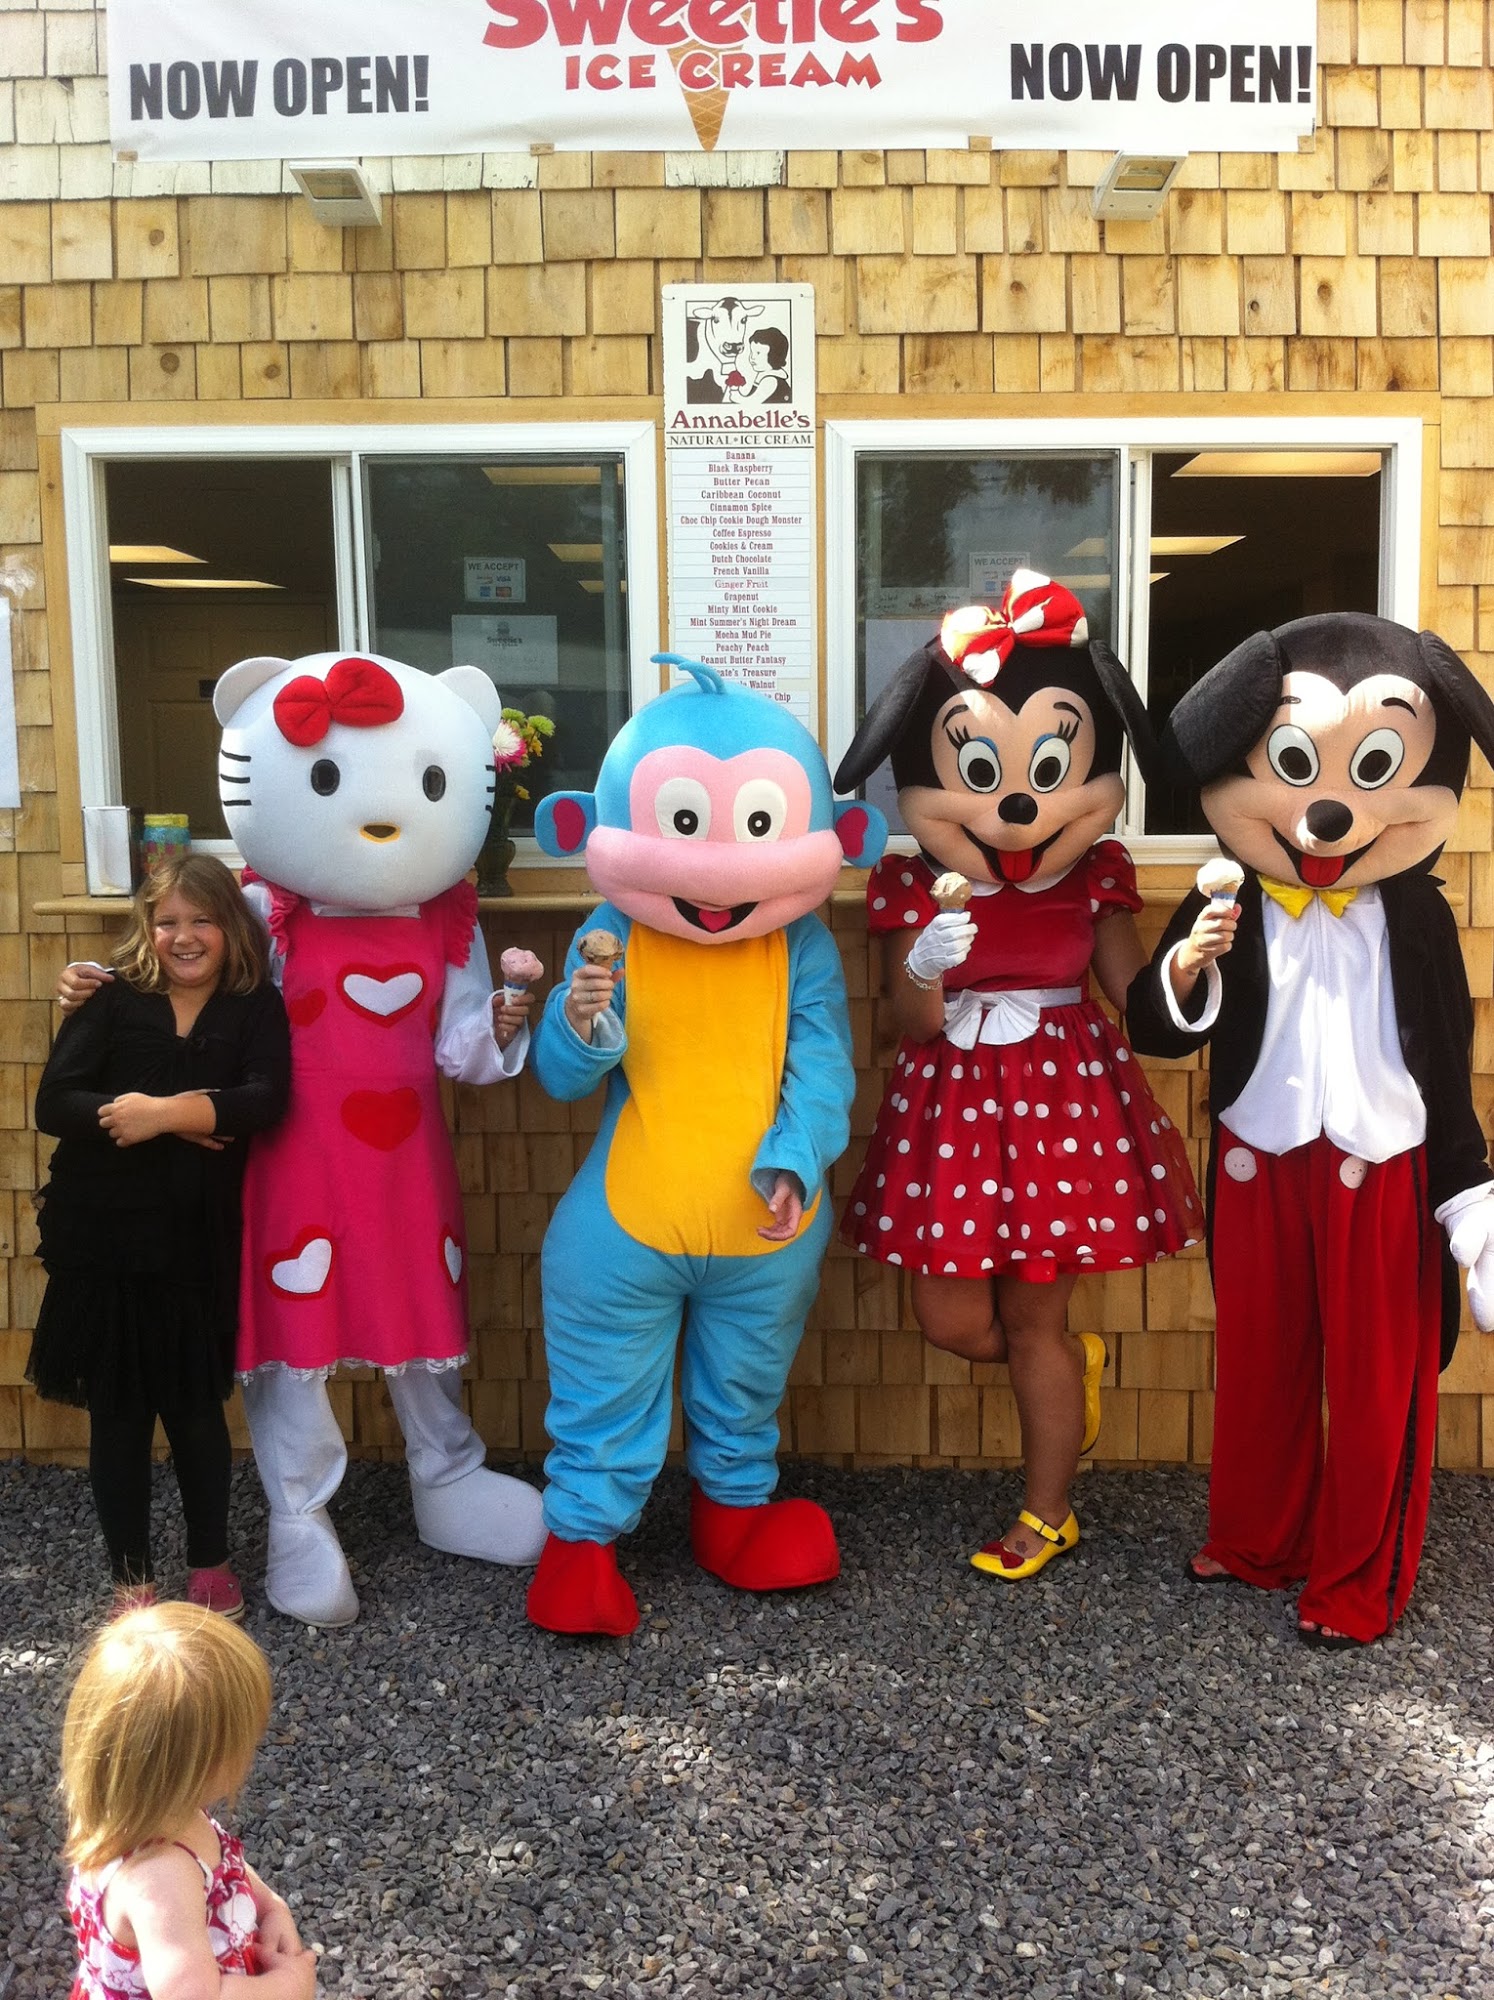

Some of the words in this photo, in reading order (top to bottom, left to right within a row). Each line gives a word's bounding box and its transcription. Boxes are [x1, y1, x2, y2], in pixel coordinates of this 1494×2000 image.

[482, 0, 944, 49] Sweeties
[565, 53, 656, 91] ICE
[679, 50, 883, 90] CREAM
[1010, 43, 1142, 102] NOW
[1156, 43, 1312, 104] OPEN!
[129, 60, 259, 121] NOW
[273, 54, 430, 117] OPEN!
[670, 410, 811, 429] Annabelle's
[669, 434, 733, 446] NATURAL
[740, 434, 762, 446] ICE
[764, 433, 812, 445] CREAM
[726, 451, 756, 460] Banana
[708, 463, 730, 473] Black
[733, 463, 773, 475] Raspberry
[713, 477, 741, 486] Butter
[744, 477, 770, 486] Pecan
[701, 490, 744, 499] Caribbean
[747, 490, 781, 499] Coconut
[709, 502, 748, 512] Cinnamon
[751, 502, 772, 513] Spice
[680, 515, 698, 525] Choc
[700, 515, 717, 526] Chip
[719, 515, 743, 525] Cookie
[746, 515, 769, 526] Dough
[771, 515, 802, 525] Monster
[712, 528, 736, 538] Coffee
[738, 528, 772, 539] Espresso
[709, 541, 738, 551] Cookies
[749, 541, 773, 551] Cream
[711, 554, 733, 564] Dutch
[735, 554, 772, 564] Chocolate
[974, 558, 988, 566] WE
[990, 557, 1024, 566] ACCEPT
[468, 562, 481, 571] WE
[484, 562, 519, 571] ACCEPT
[713, 567, 740, 576] French
[742, 567, 769, 576] Vanilla
[724, 592, 759, 602] Grapenut
[707, 605, 729, 616] Minty
[732, 605, 750, 614] Mint
[752, 605, 778, 614] Cookie
[690, 617, 707, 627] Mint
[709, 617, 747, 627] Summer's
[749, 617, 770, 628] Night
[772, 617, 797, 627] Dream
[715, 630, 740, 640] Mocha
[741, 630, 758, 640] Mud
[759, 630, 772, 640] Pie
[716, 643, 743, 654] Peachy
[746, 643, 770, 652] Peach
[701, 655, 728, 664] Peanut
[729, 655, 754, 664] Butter
[756, 655, 787, 666] Fantasy
[742, 668, 777, 677] Treasure
[749, 680, 776, 689] Walnut
[774, 692, 791, 702] Chip
